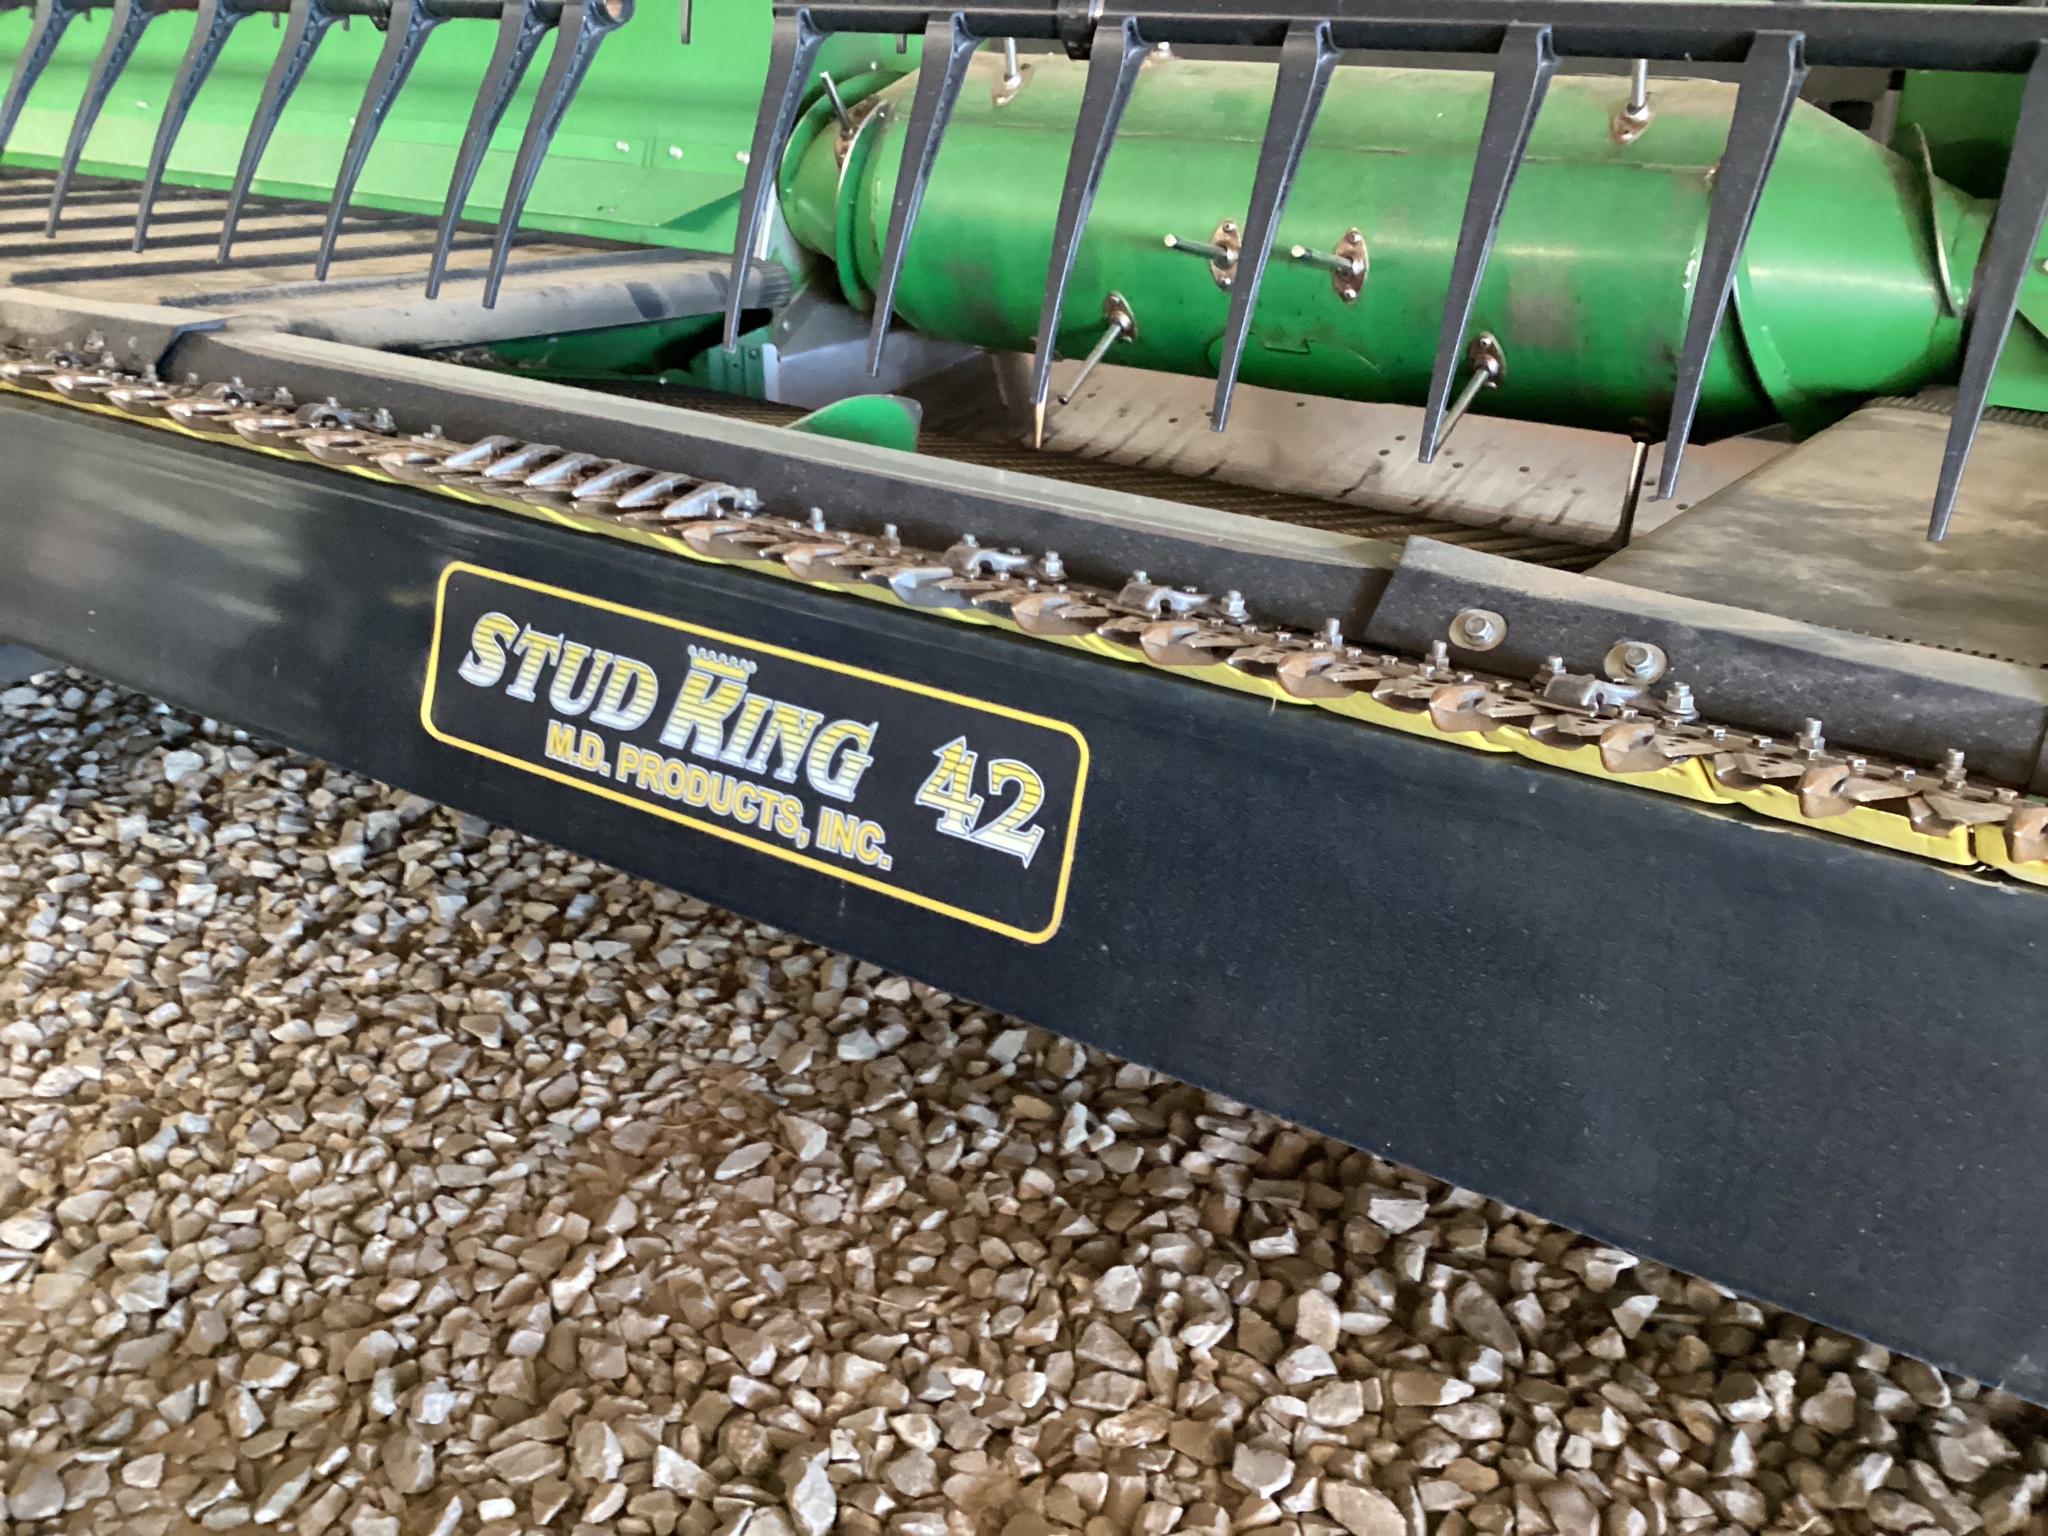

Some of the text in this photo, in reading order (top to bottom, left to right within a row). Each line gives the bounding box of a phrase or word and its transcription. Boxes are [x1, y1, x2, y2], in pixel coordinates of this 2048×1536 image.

[458, 611, 880, 803] STUD KING
[544, 719, 893, 870] M.D. PRODUCTS, INC.
[915, 735, 1046, 869] 42
